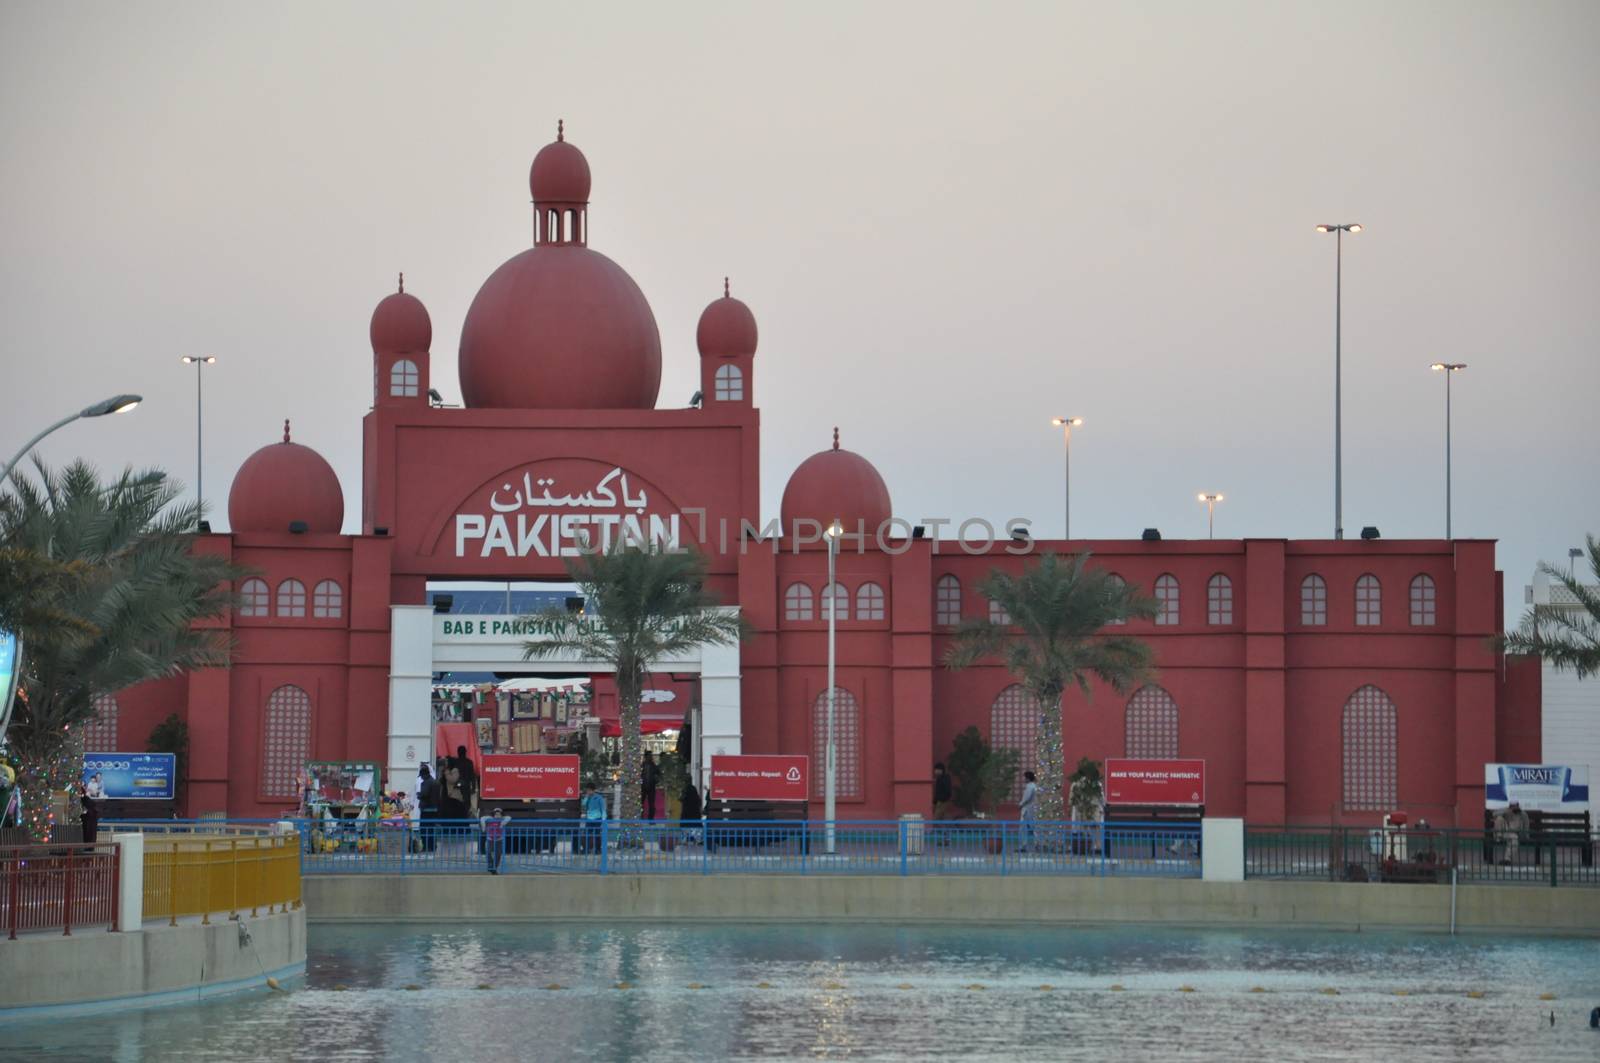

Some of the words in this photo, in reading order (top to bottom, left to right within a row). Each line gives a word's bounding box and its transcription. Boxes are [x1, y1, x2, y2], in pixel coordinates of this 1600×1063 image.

[490, 467, 647, 515] باكستان
[455, 513, 680, 558] PAKISTAN
[443, 620, 474, 636] BAB
[480, 620, 487, 635] E
[492, 620, 567, 637] PAKISTAN
